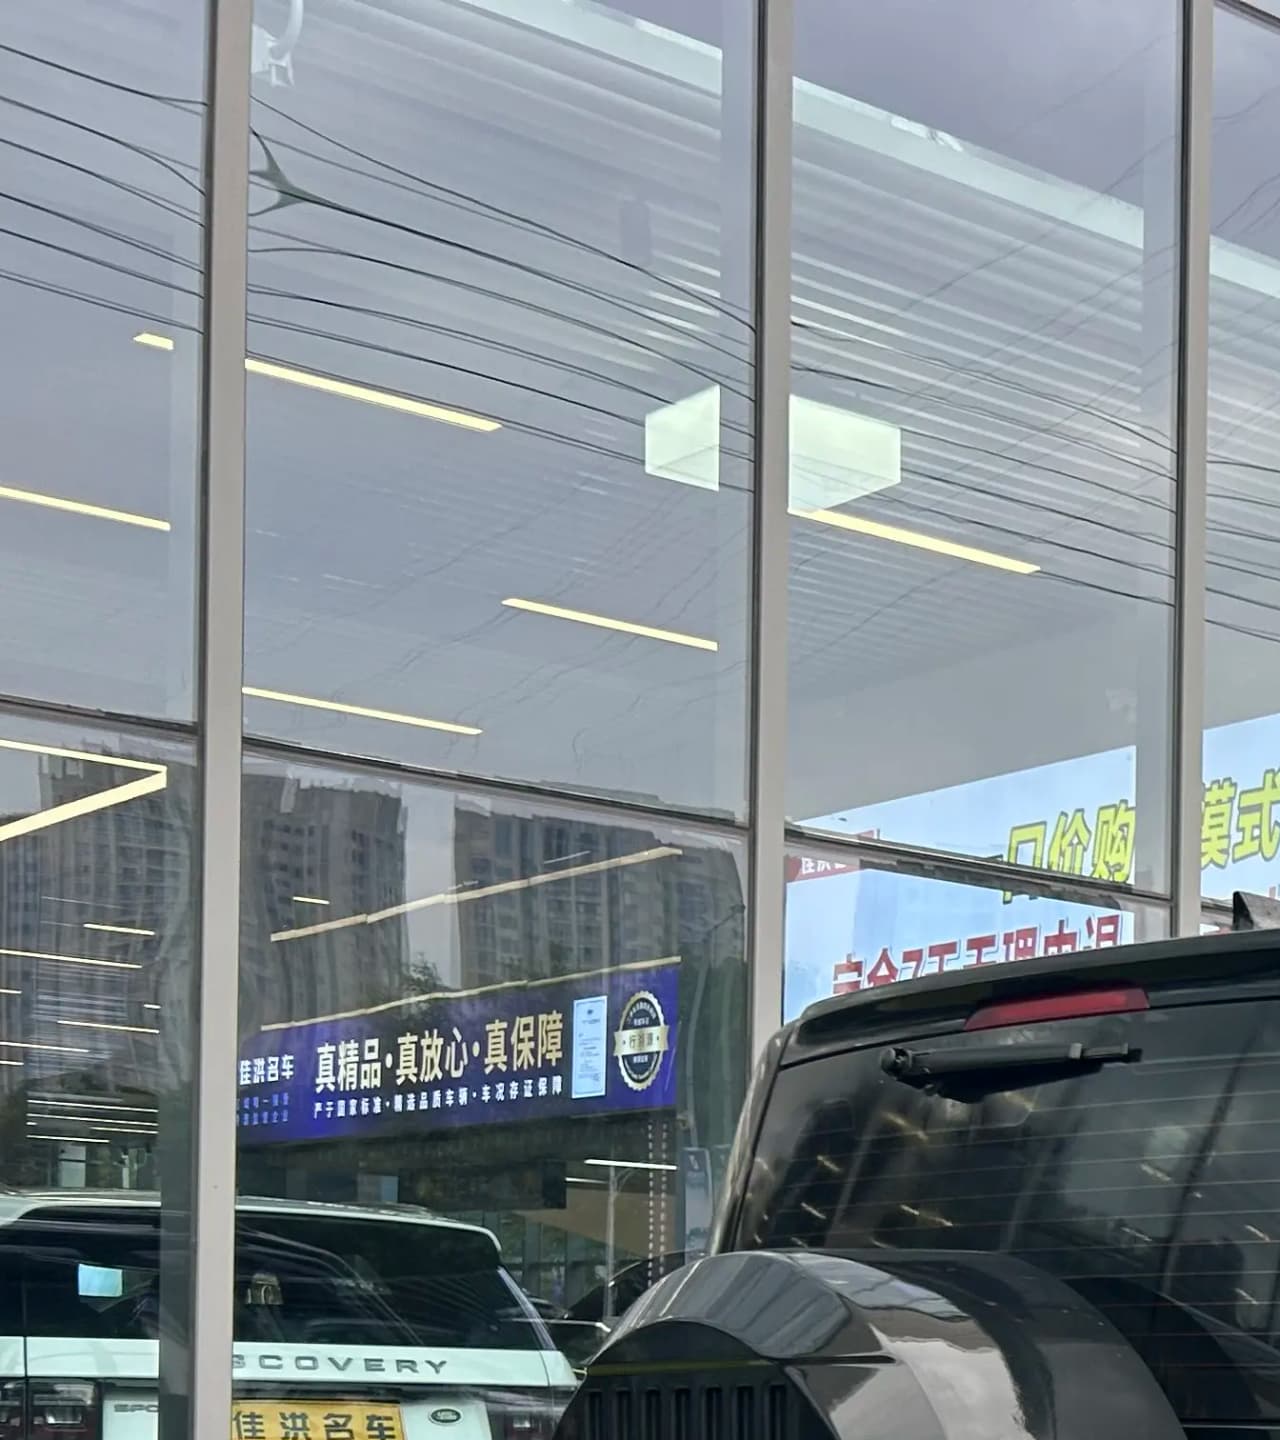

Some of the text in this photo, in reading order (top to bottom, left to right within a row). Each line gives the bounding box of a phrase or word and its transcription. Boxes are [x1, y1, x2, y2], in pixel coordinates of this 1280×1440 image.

[239, 1055, 295, 1086] 佳洪名车
[315, 1010, 564, 1094] 真精品·真放心·真保障
